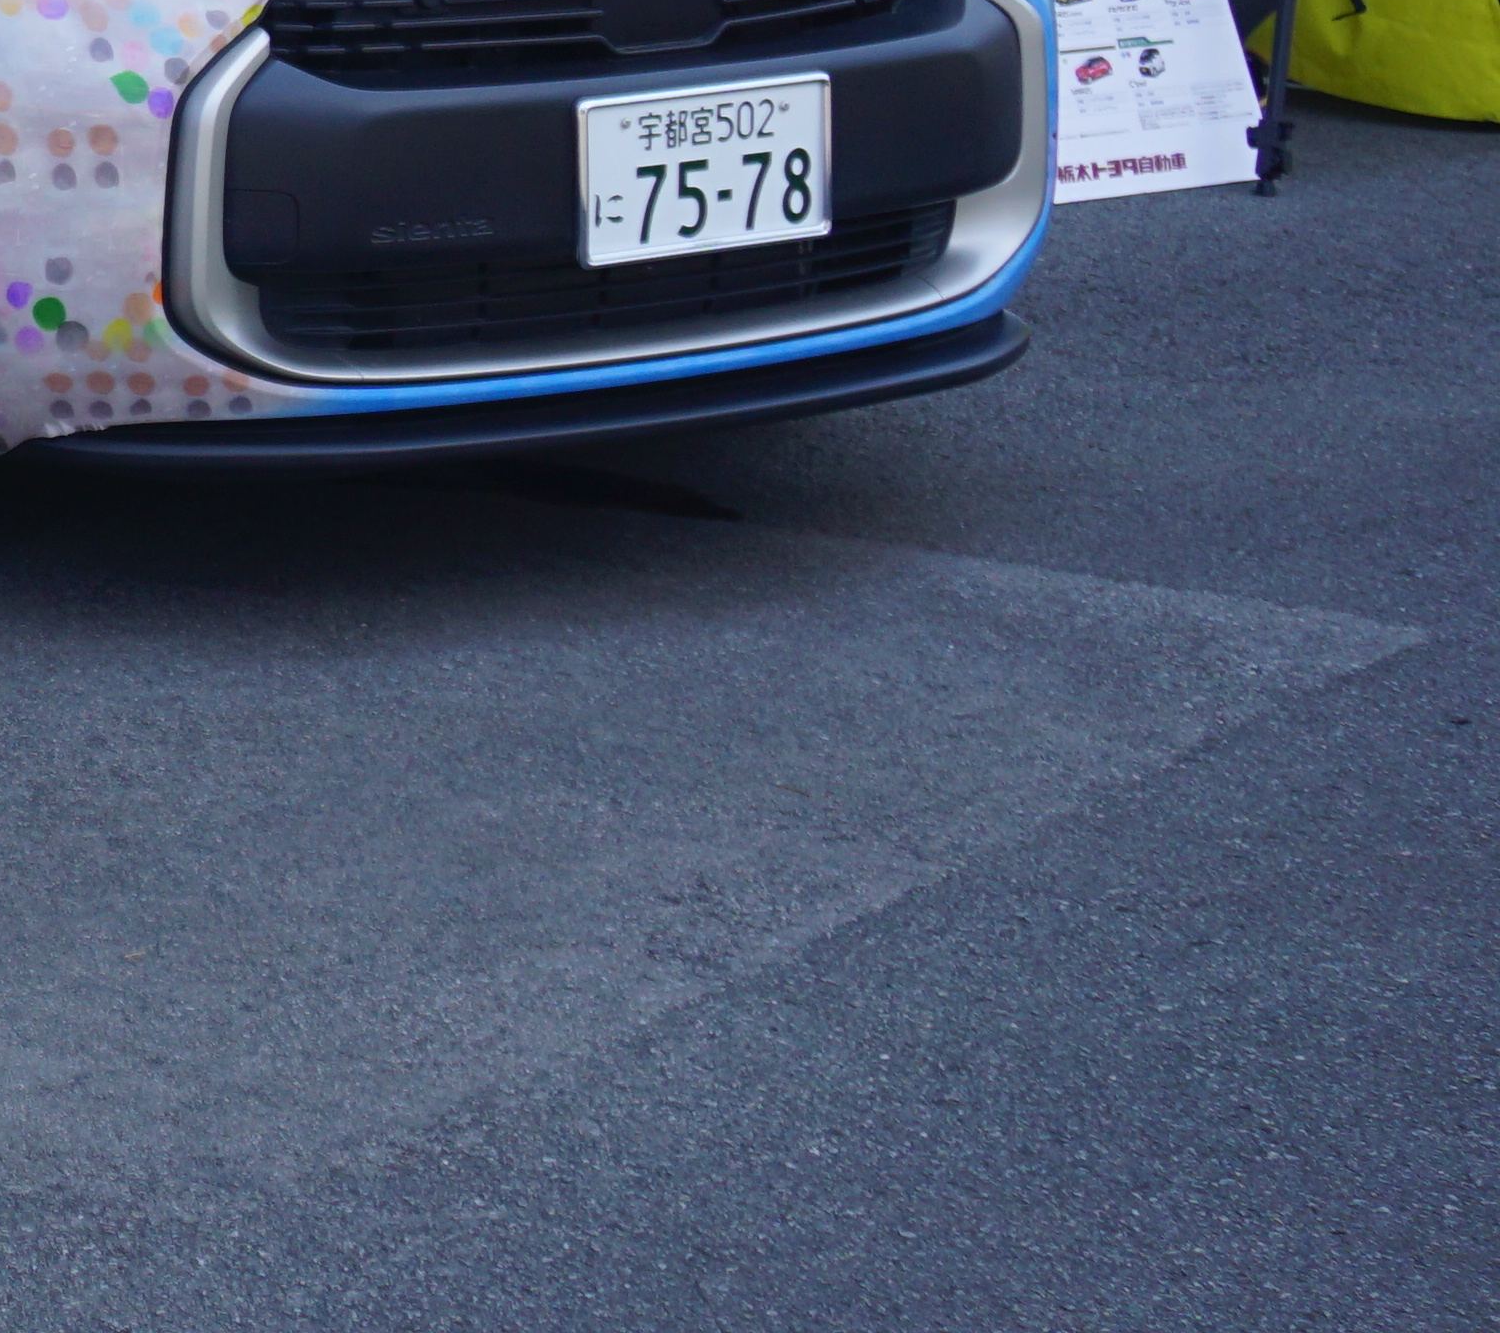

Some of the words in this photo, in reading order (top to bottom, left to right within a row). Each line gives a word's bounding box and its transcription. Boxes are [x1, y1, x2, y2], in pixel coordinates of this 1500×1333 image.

[637, 98, 775, 151] 宇都宮502
[595, 191, 625, 229] に
[635, 147, 813, 245] 75-78
